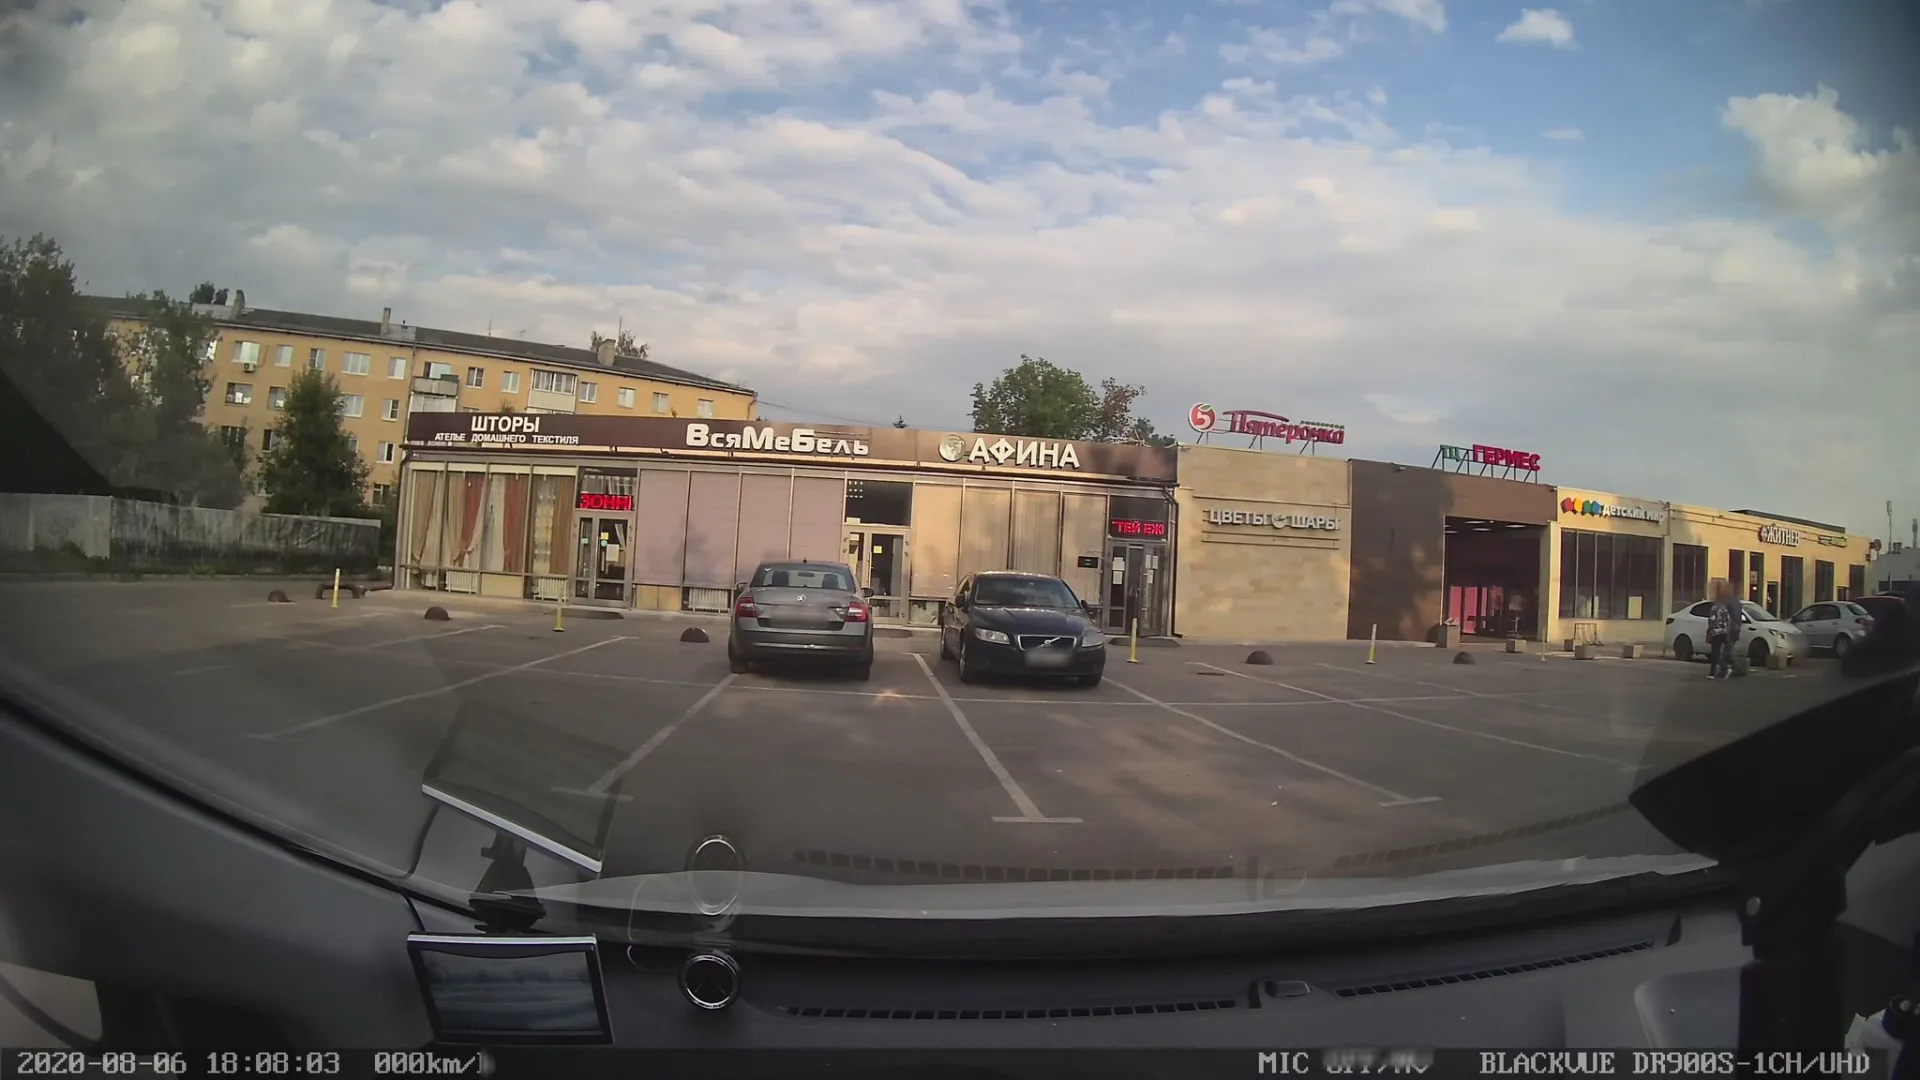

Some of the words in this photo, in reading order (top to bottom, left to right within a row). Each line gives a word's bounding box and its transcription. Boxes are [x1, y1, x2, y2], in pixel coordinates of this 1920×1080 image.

[470, 416, 541, 434] ШТОРЫ
[685, 422, 869, 456] ВсяМеБель
[1222, 409, 1345, 445] Пятерочка
[434, 433, 466, 442] АТЕЛЬЕ
[471, 434, 527, 444] ДОМАШНЕГО
[532, 435, 579, 446] ТЕКСТИЛЯ
[968, 437, 1081, 469] АФИНА
[1472, 444, 1541, 472] ГЕРМЕС
[1209, 508, 1268, 525] ЦВЕТЫ
[1291, 515, 1340, 530] ШАРЫ
